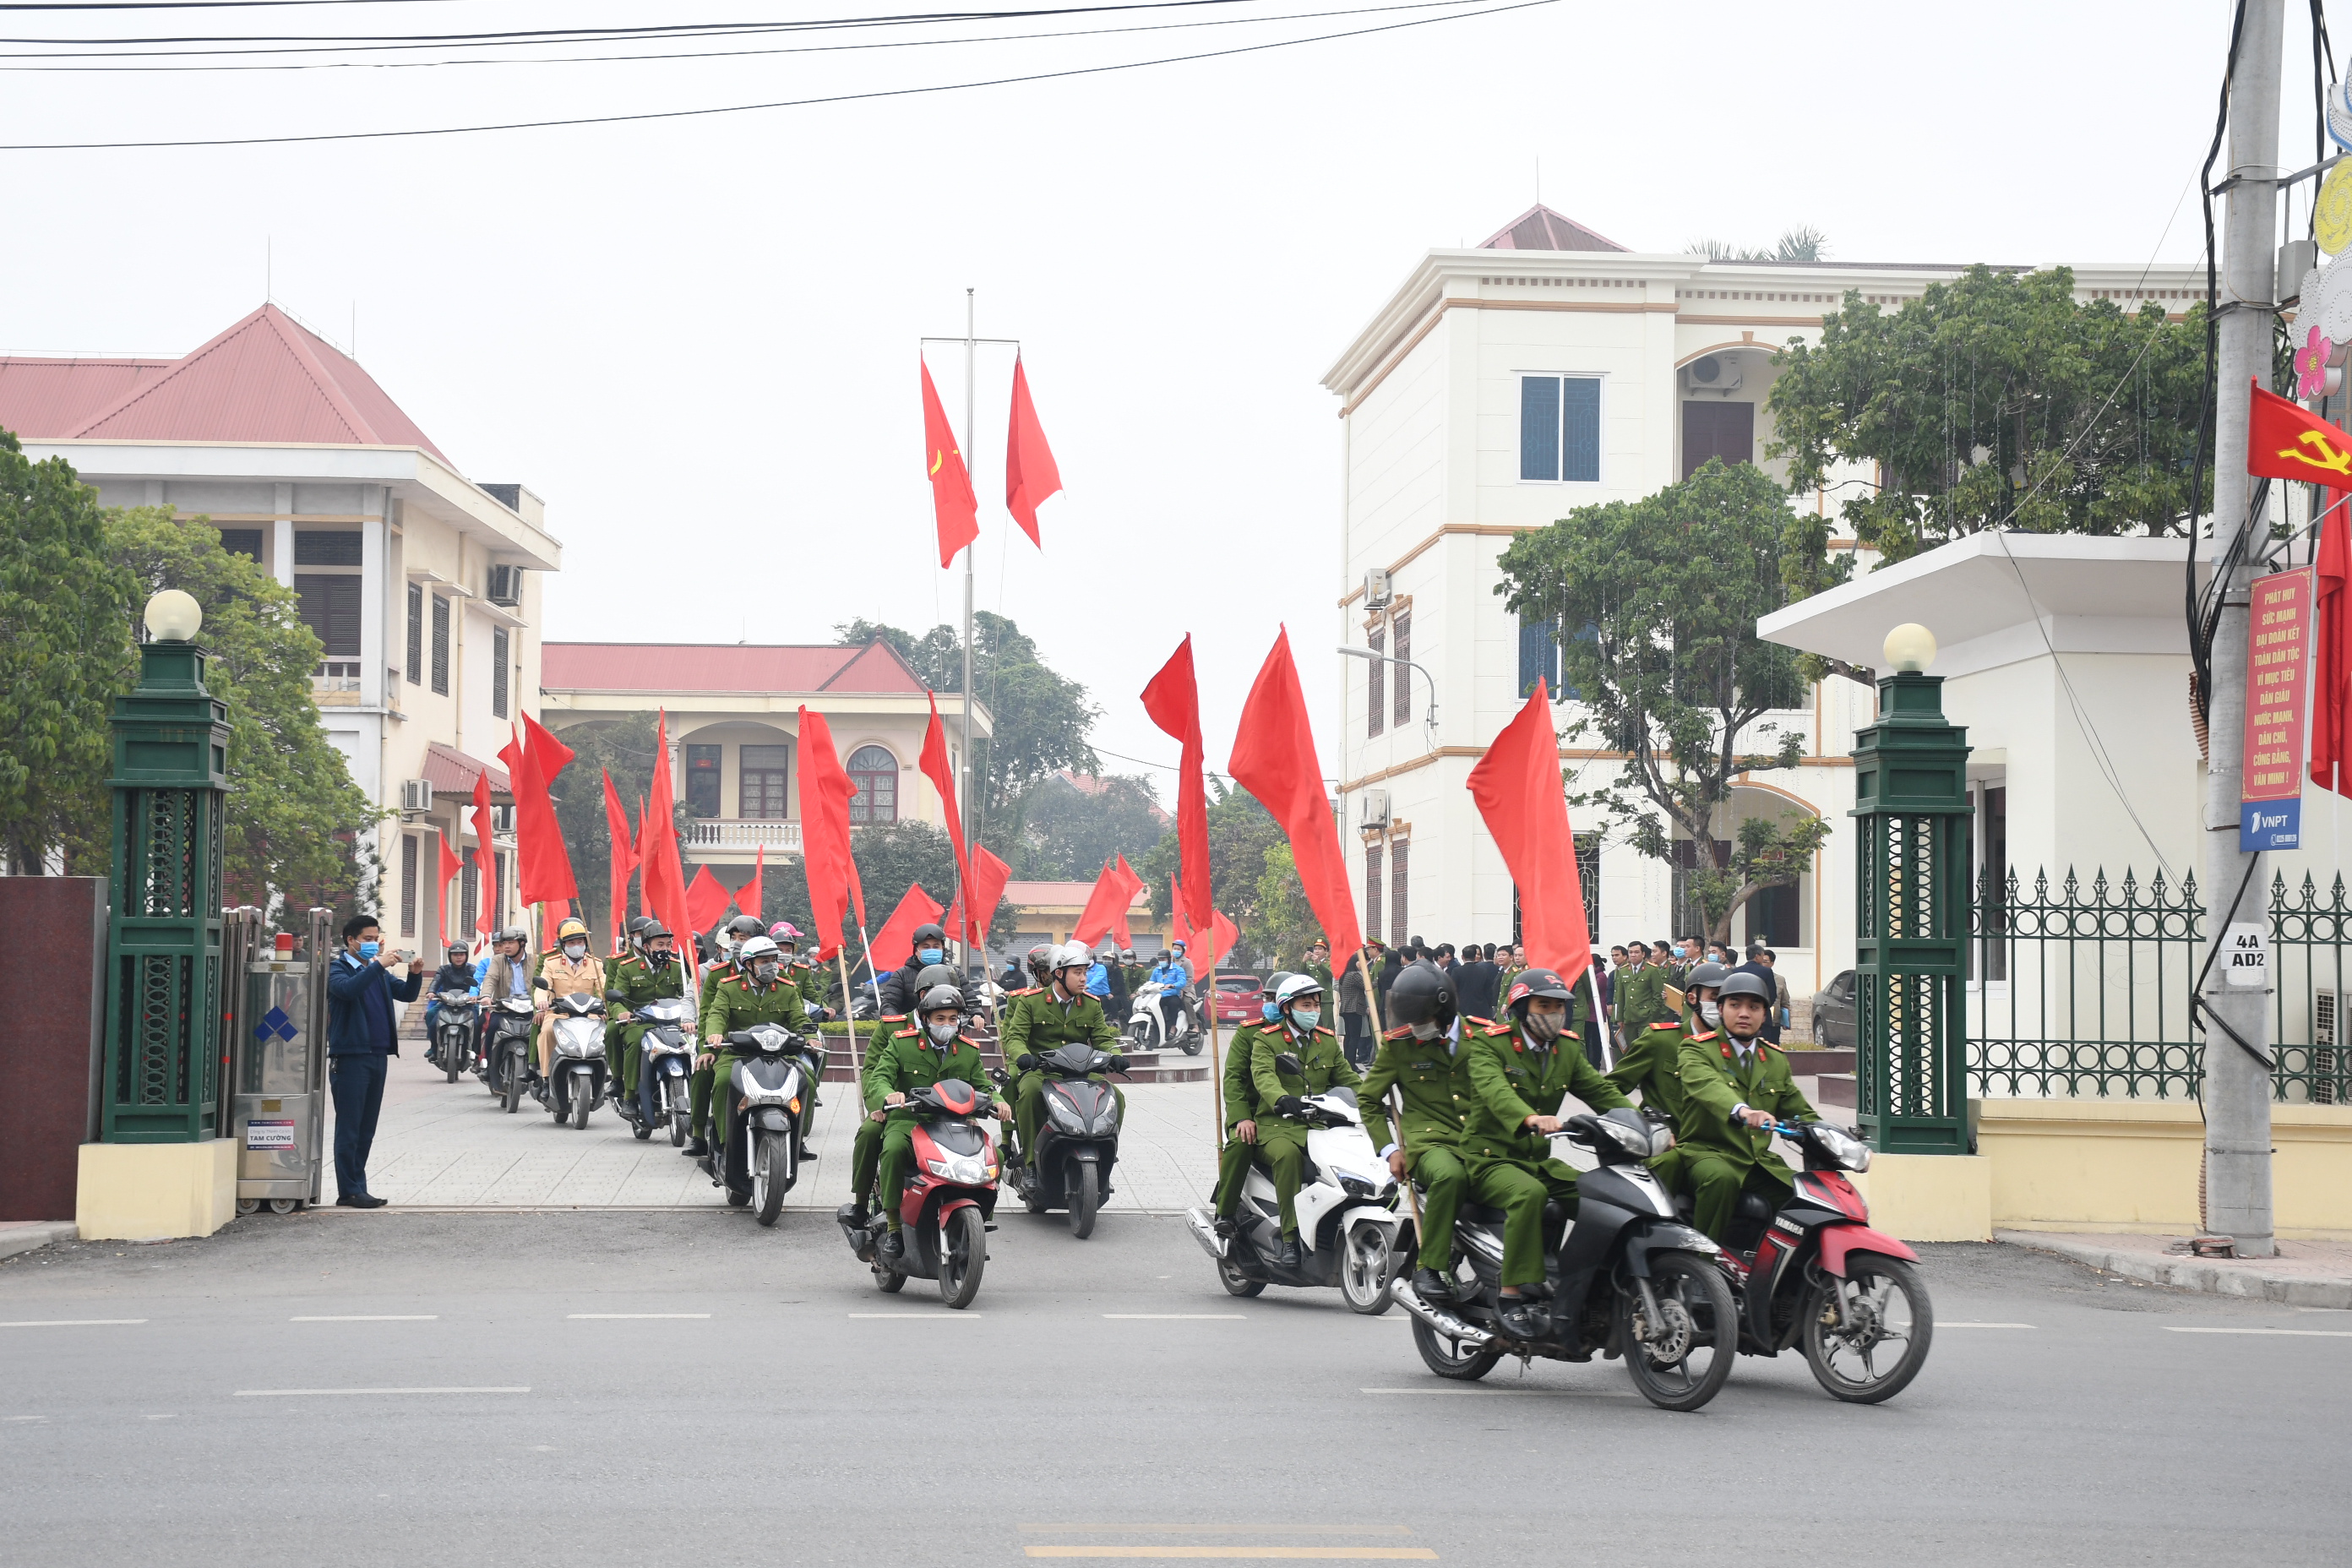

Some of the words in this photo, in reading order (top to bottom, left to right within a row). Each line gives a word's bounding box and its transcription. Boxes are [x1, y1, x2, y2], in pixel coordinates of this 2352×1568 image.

[2265, 589, 2281, 605] PHÁT
[2283, 587, 2295, 602] HUY
[2262, 611, 2275, 625] SỨC
[2276, 607, 2296, 624] MẠNH
[2257, 634, 2268, 648] ĐẠI
[2268, 629, 2286, 644] ĐOÀN
[2287, 623, 2300, 640] KẾT
[2255, 651, 2271, 667] TOÀN
[2272, 649, 2286, 663] DÂN
[2287, 645, 2300, 663] TỘC
[2257, 672, 2264, 686] VÌ
[2265, 672, 2279, 686] MỤC
[2281, 667, 2295, 682] TIÊU
[2260, 691, 2273, 705] DÂN
[2274, 689, 2290, 704] GIÀU
[2254, 710, 2272, 726] NƯỚC
[2273, 710, 2294, 725] MẠNH,
[2258, 731, 2272, 745] DÂN
[2273, 727, 2288, 743] CHỦ,
[2253, 751, 2270, 766] CÔNG
[2272, 747, 2291, 765] BẰNG,
[2253, 772, 2267, 786] VĂN
[2268, 771, 2284, 785] MINH
[2262, 815, 2288, 828] VNPT
[2236, 935, 2259, 948] 4A
[2232, 953, 2264, 966] AD2
[1775, 1216, 1805, 1236] YAMAHA
